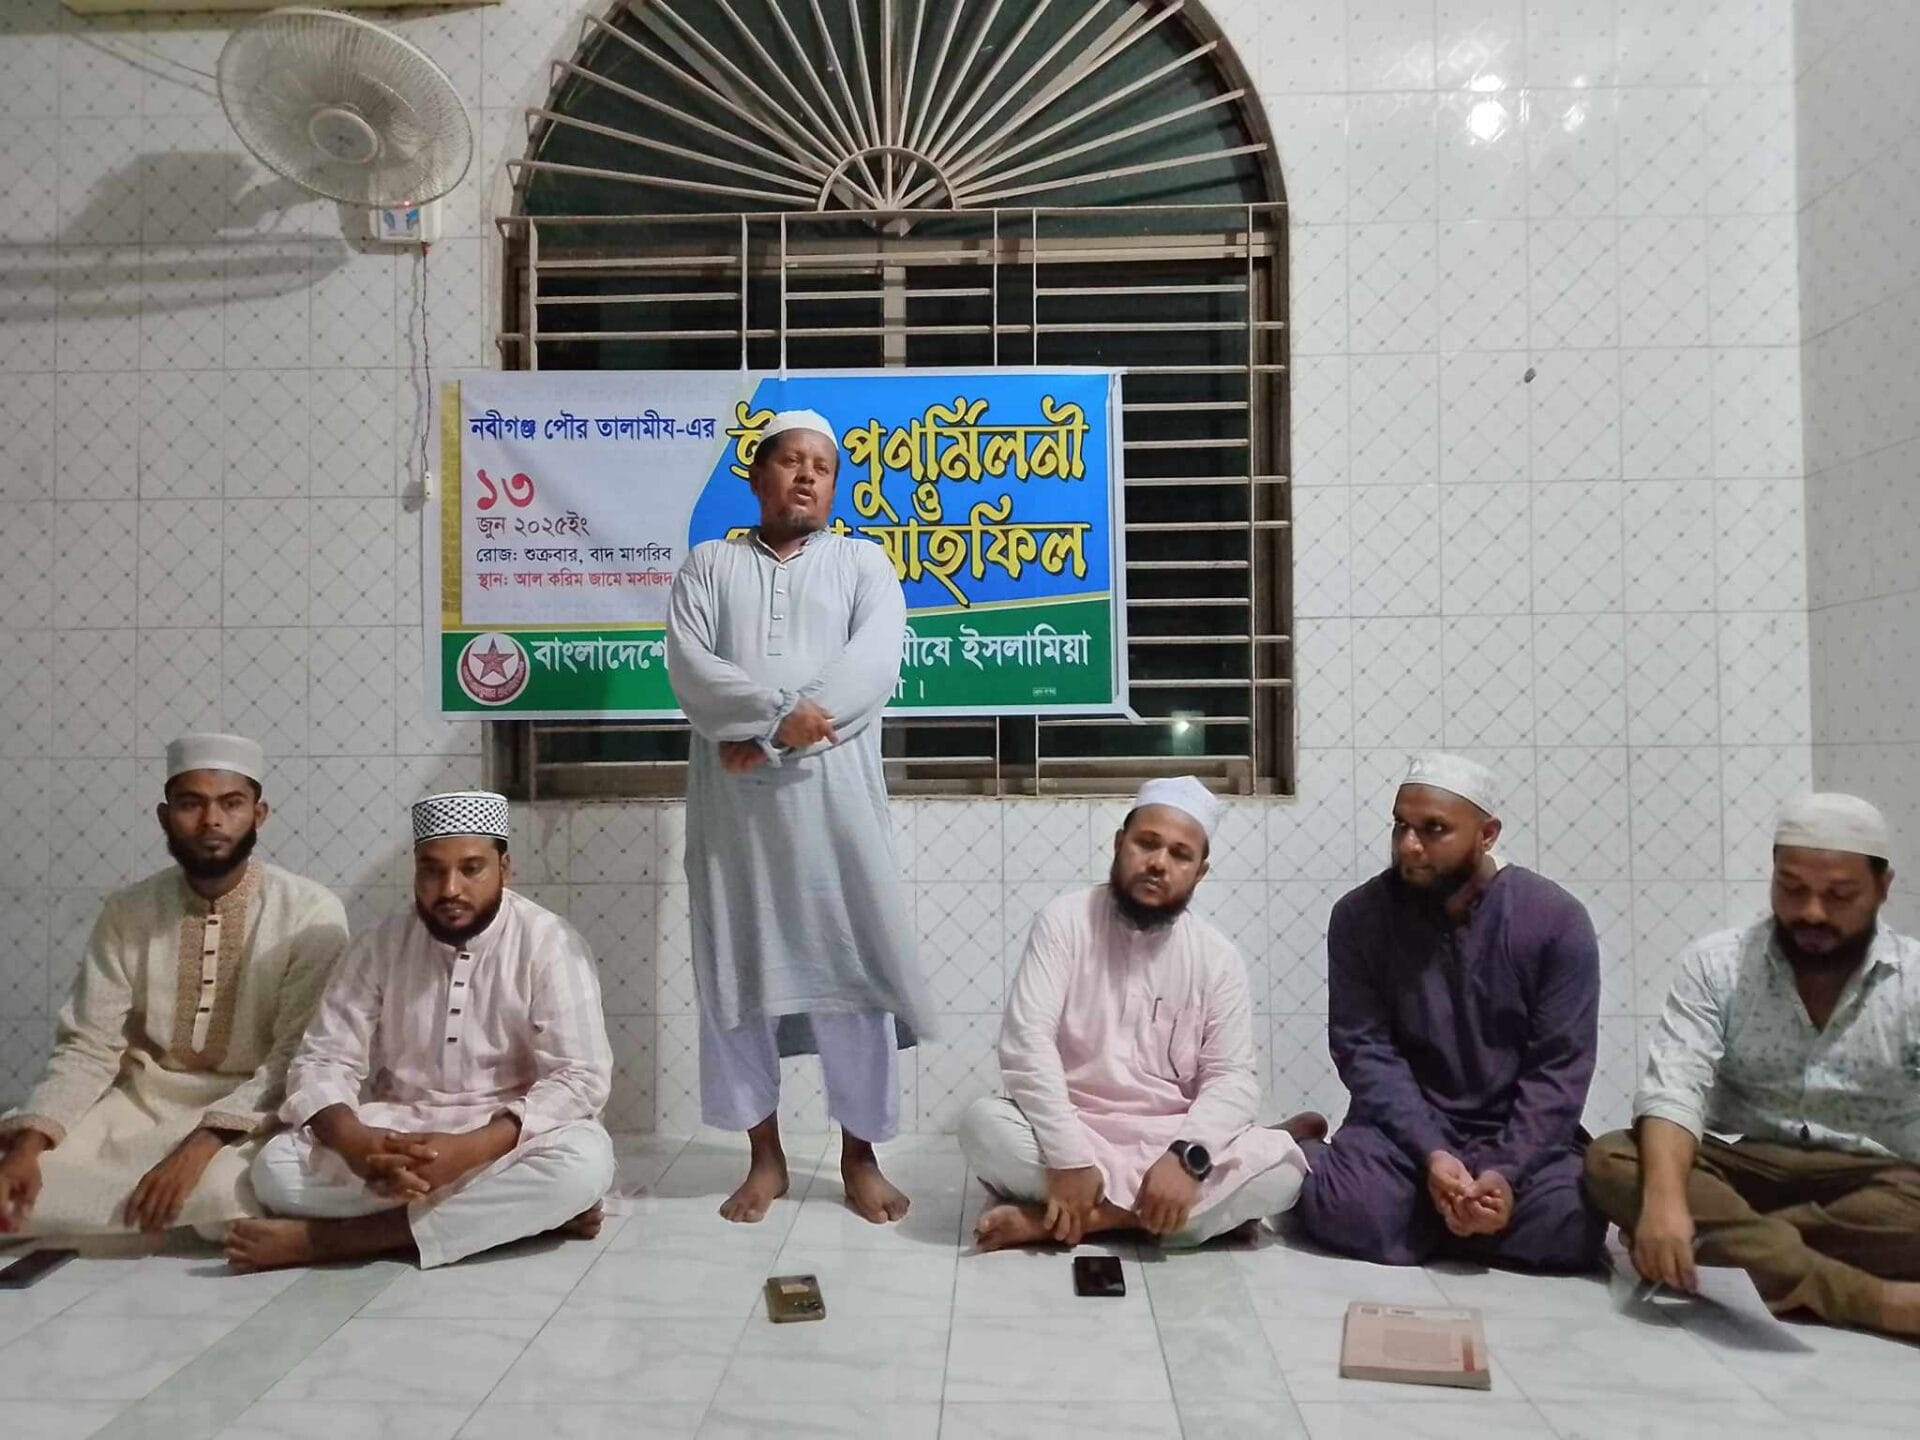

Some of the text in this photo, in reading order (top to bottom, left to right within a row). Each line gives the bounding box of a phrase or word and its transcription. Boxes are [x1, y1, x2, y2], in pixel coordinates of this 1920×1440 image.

[470, 409, 716, 440] নবীগঞ্জ পৌর তালামীয-এর
[477, 469, 535, 510] ১৩
[912, 481, 942, 523] ও
[476, 511, 590, 540] জুন ২০২৫ইং
[476, 548, 517, 563] রোজ:
[590, 548, 614, 563] বাদ
[619, 543, 672, 563] মাগরিব
[514, 571, 542, 587] আল
[548, 566, 583, 587] করিম
[589, 571, 622, 587] জামে
[626, 566, 673, 587] মসজিদ
[958, 623, 1092, 671] ইসলামিয়া
